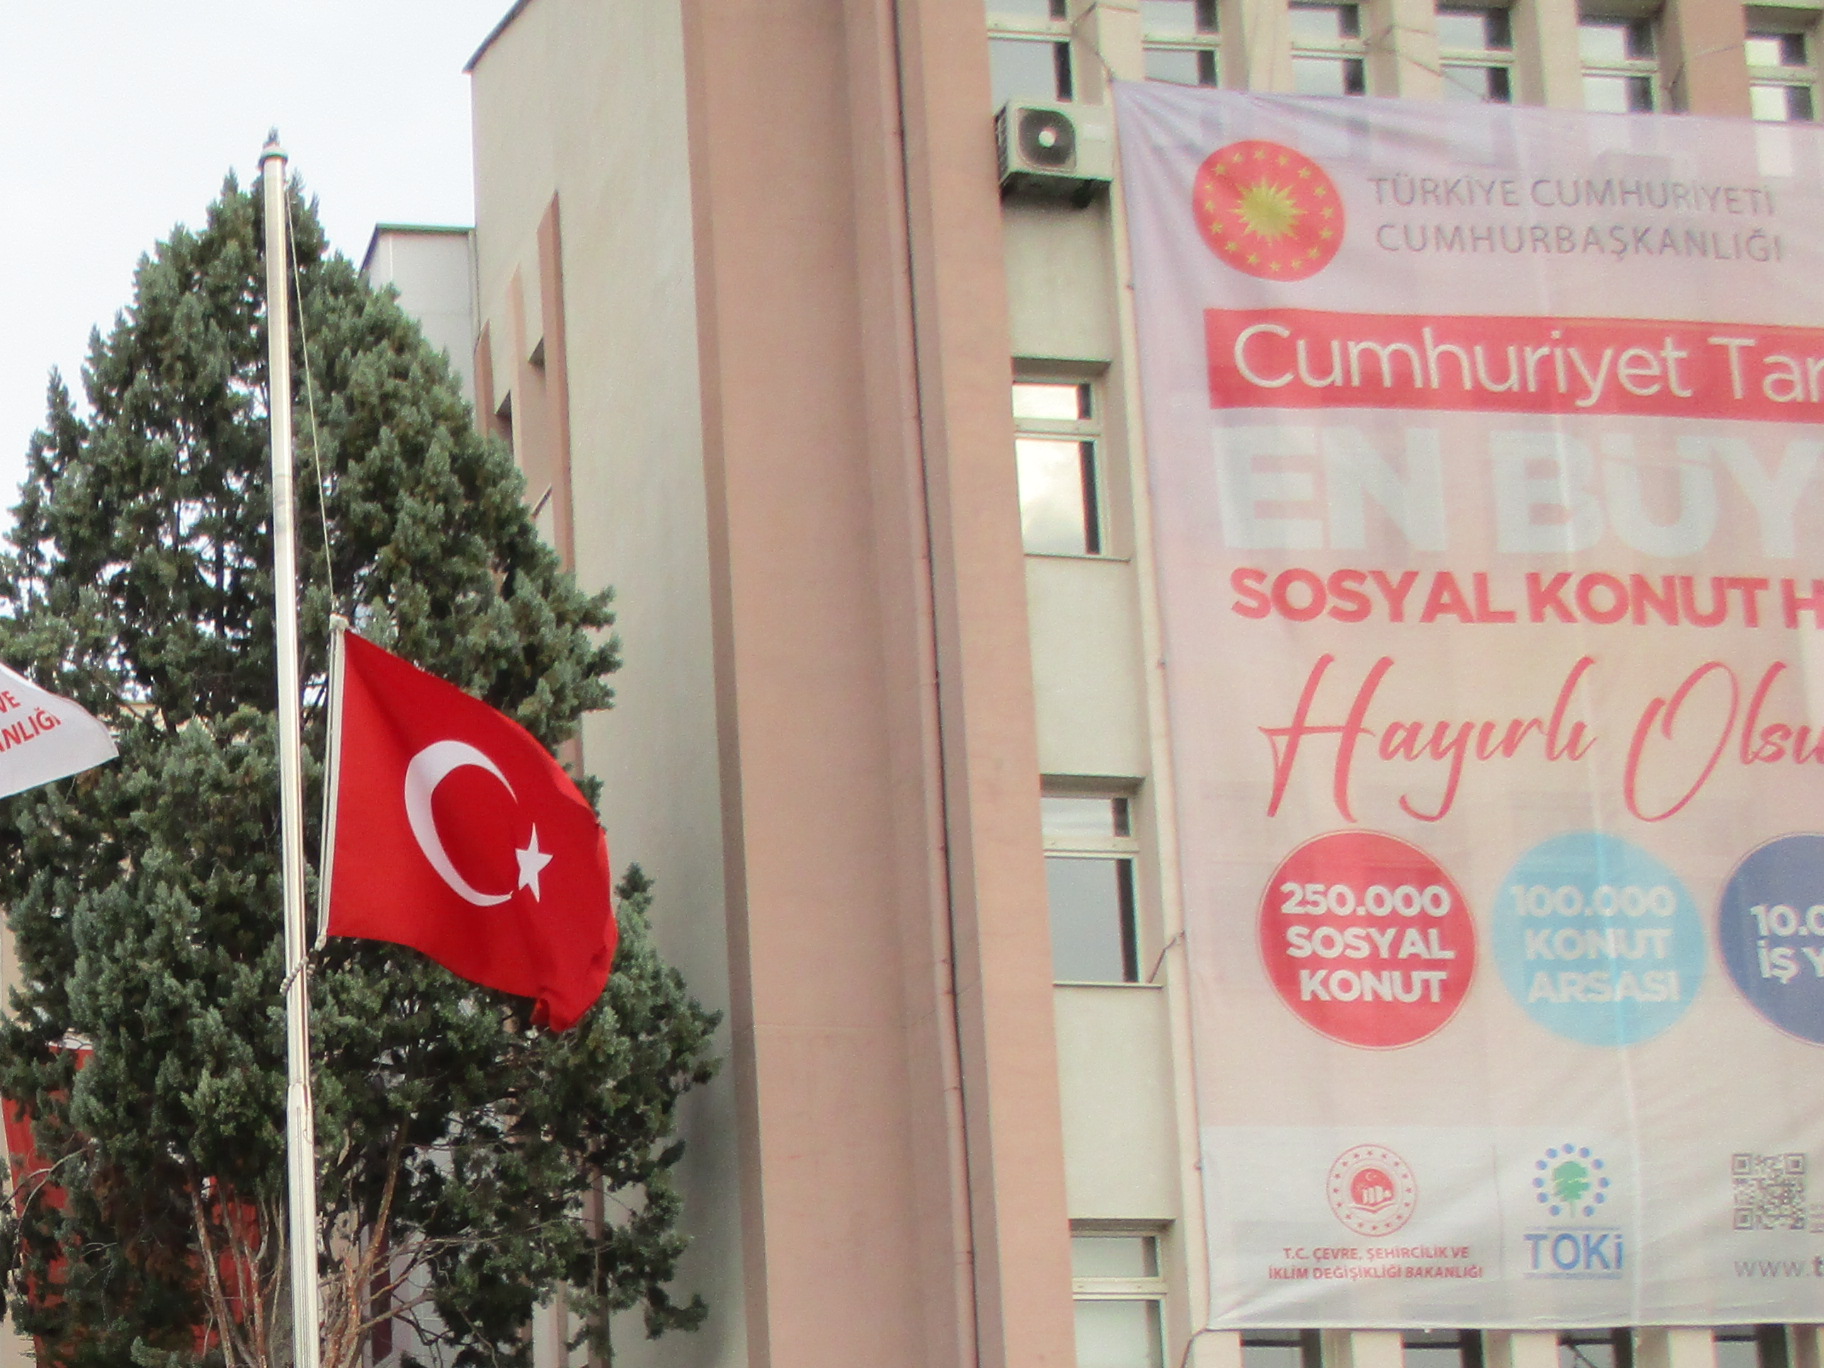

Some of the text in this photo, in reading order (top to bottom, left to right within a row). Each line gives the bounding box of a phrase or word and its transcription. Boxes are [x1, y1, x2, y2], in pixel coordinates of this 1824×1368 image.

[1367, 172, 1776, 216] TÜRKİYE CUMHURİYETİ
[1376, 223, 1782, 262] CUMHURBAŞKANLIĞI
[1233, 323, 1693, 409] Cumhuriyet
[1212, 424, 1448, 552] EN
[1230, 567, 1517, 624] SOSYAL
[1526, 571, 1770, 628] KONUT
[1257, 652, 1597, 822] Hayırlı
[1279, 881, 1452, 918] 250.000
[1511, 883, 1677, 918] 100.000
[1285, 924, 1457, 960] SOSYAL
[1525, 927, 1674, 961] KONUT
[1756, 939, 1800, 985] İŞ
[1299, 968, 1448, 1004] KONUT
[1527, 970, 1680, 1004] ARSASI
[1267, 1264, 1309, 1280] İKLİM
[1404, 1264, 1484, 1279] BAKANLIĞI
[1282, 1247, 1309, 1261] T.C.
[1451, 1246, 1470, 1260] VE
